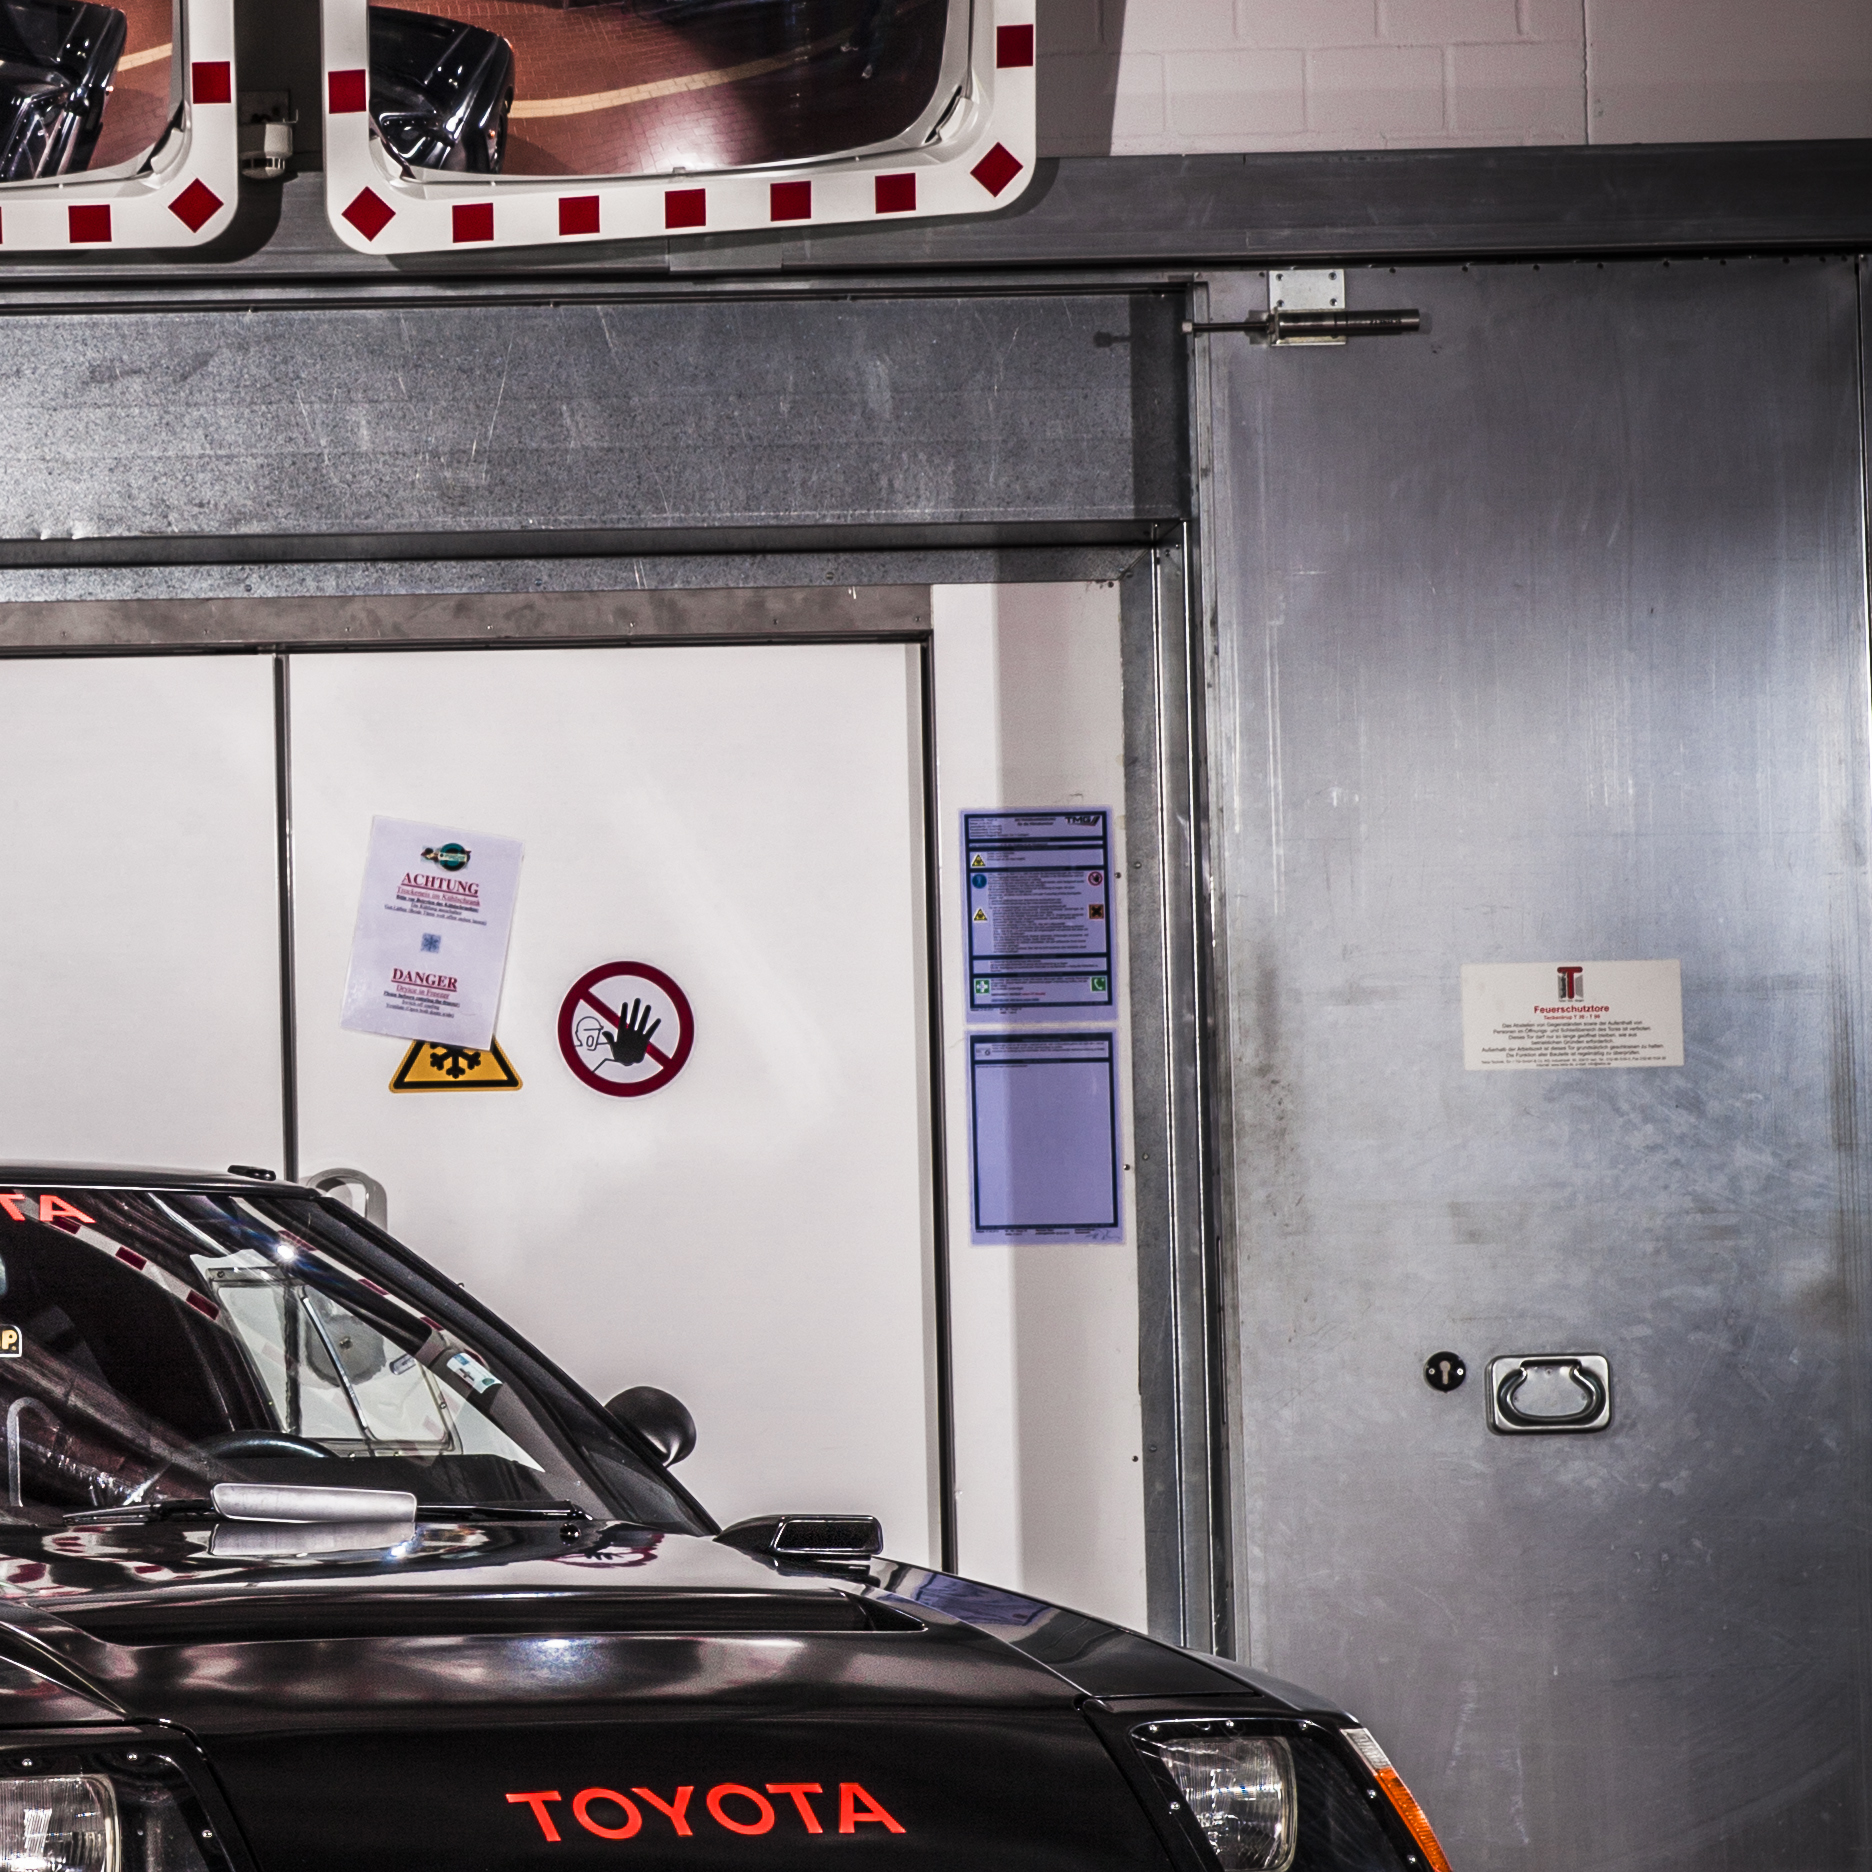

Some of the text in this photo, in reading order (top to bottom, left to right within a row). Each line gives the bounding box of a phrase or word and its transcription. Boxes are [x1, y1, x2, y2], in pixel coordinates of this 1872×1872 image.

[1065, 816, 1092, 824] TMG
[401, 872, 480, 896] ACHTUNG
[392, 968, 458, 990] DANGER
[1534, 1004, 1610, 1014] Feuerschutztore
[506, 1782, 906, 1841] TOYOTA
